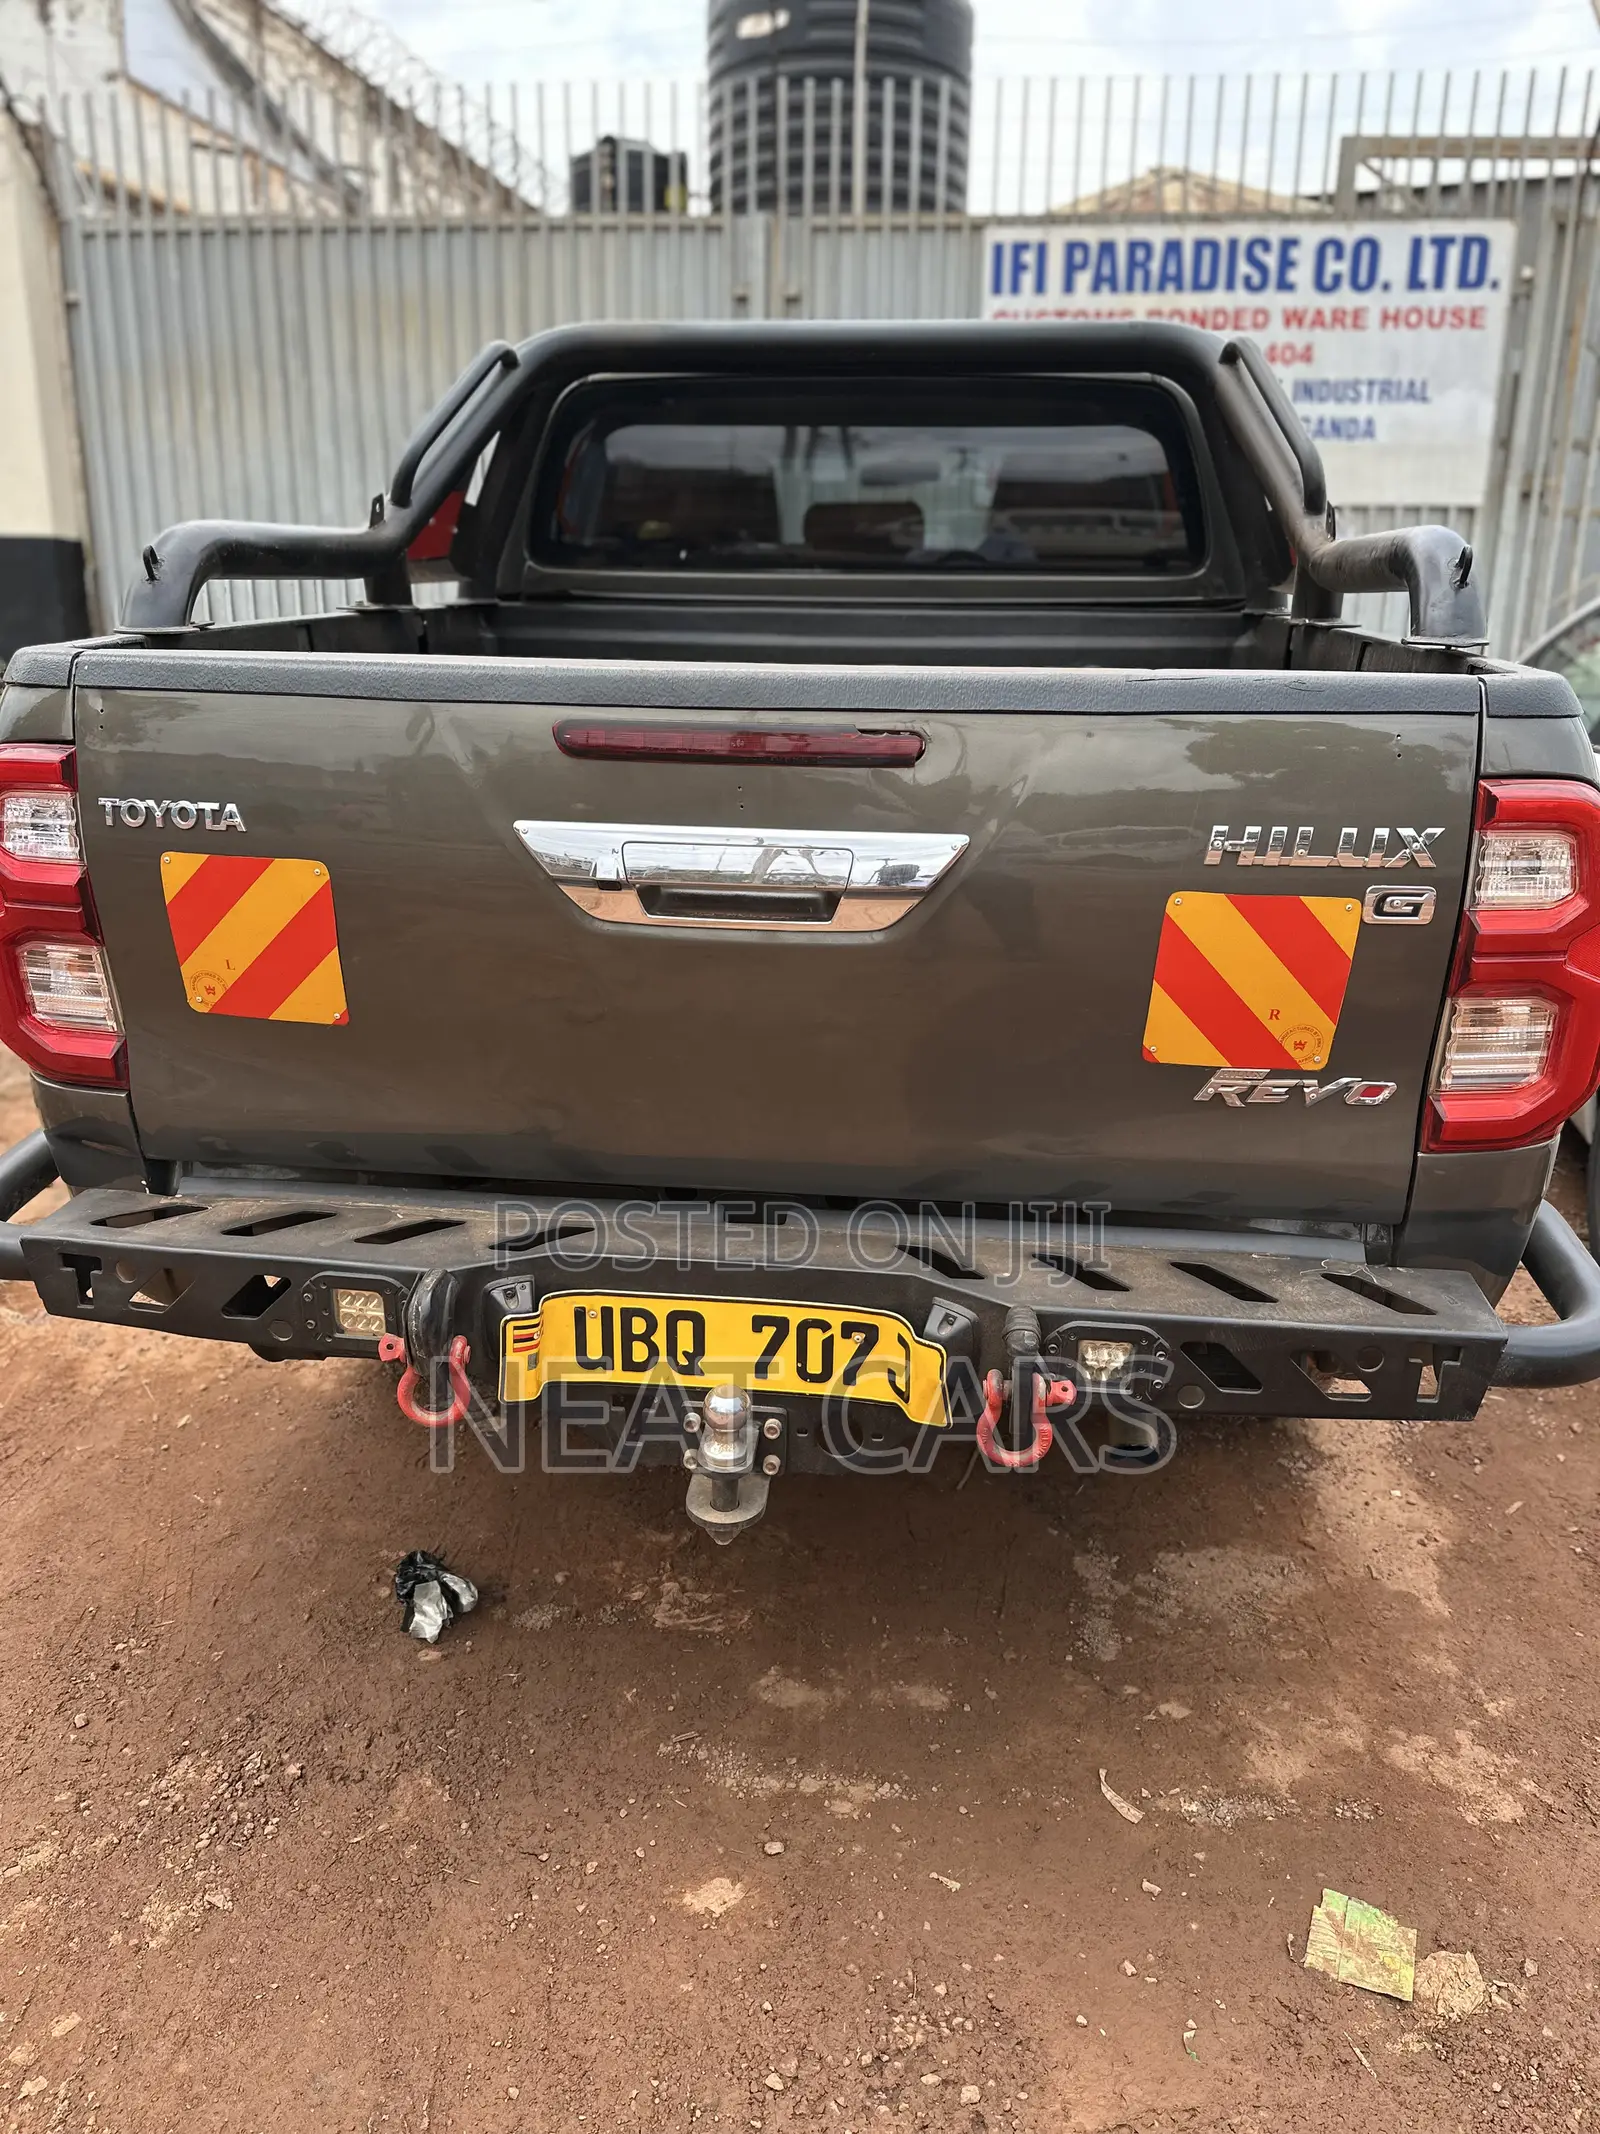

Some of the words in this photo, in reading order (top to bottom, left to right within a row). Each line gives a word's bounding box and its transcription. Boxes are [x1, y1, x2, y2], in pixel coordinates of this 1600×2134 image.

[991, 241, 1048, 296] IFI
[1062, 237, 1300, 294] PARADISE
[1312, 236, 1391, 292] CO.
[1405, 235, 1499, 291] LTD.
[1282, 305, 1369, 331] WARE
[1379, 304, 1487, 330] HOUSE
[1265, 343, 1315, 366] 404
[1292, 378, 1431, 404] INDUSTRIAL
[98, 797, 247, 832] TOYOTA
[1203, 824, 1446, 868] HILUX
[1369, 888, 1434, 921] G
[225, 958, 236, 971] L
[1268, 1009, 1280, 1020] R
[1193, 1068, 1398, 1107] REVO
[573, 1305, 706, 1378] UBQ
[751, 1314, 911, 1405] 707J
